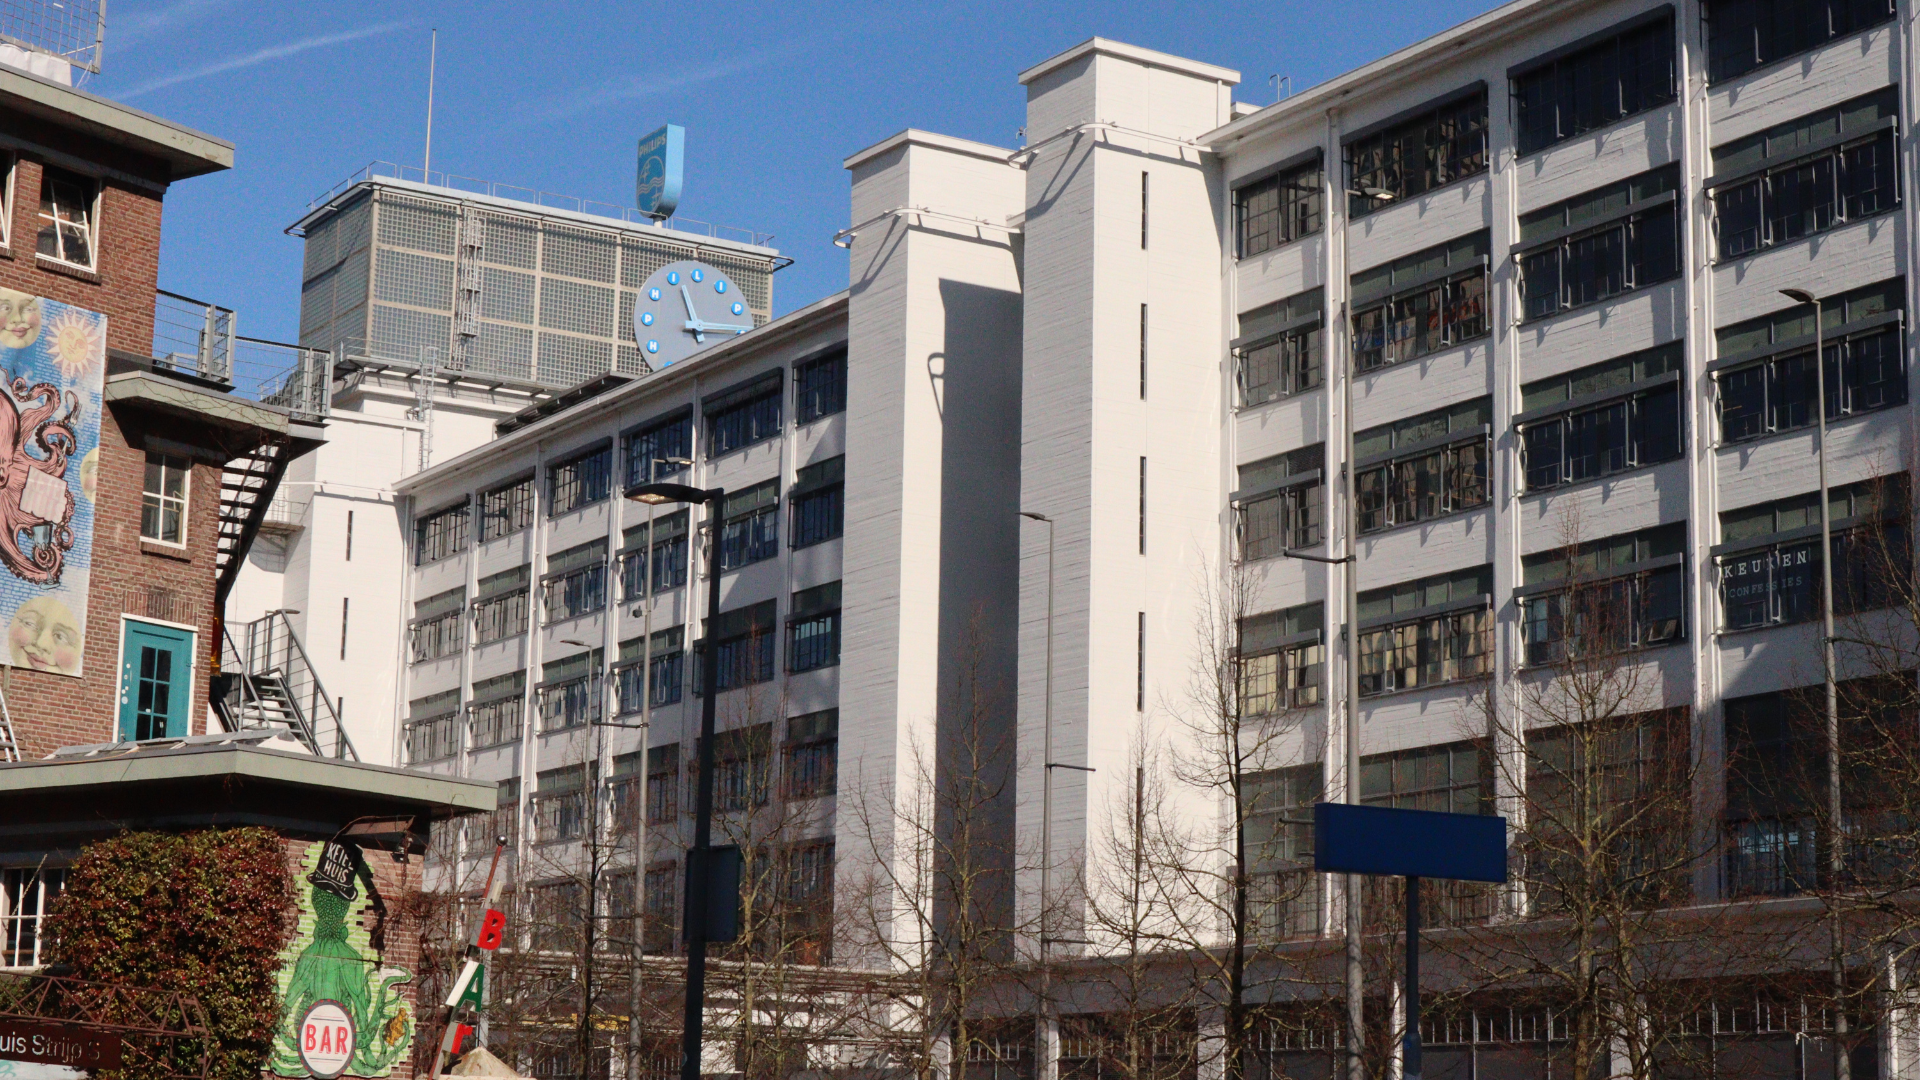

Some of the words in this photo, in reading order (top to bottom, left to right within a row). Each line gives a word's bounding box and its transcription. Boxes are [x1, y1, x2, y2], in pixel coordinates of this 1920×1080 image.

[639, 133, 667, 158] PHILIPS
[1729, 576, 1803, 598] CONFESSIES
[323, 860, 349, 883] HUIS
[31, 1034, 83, 1063] Strijp
[304, 1023, 348, 1055] BAR
